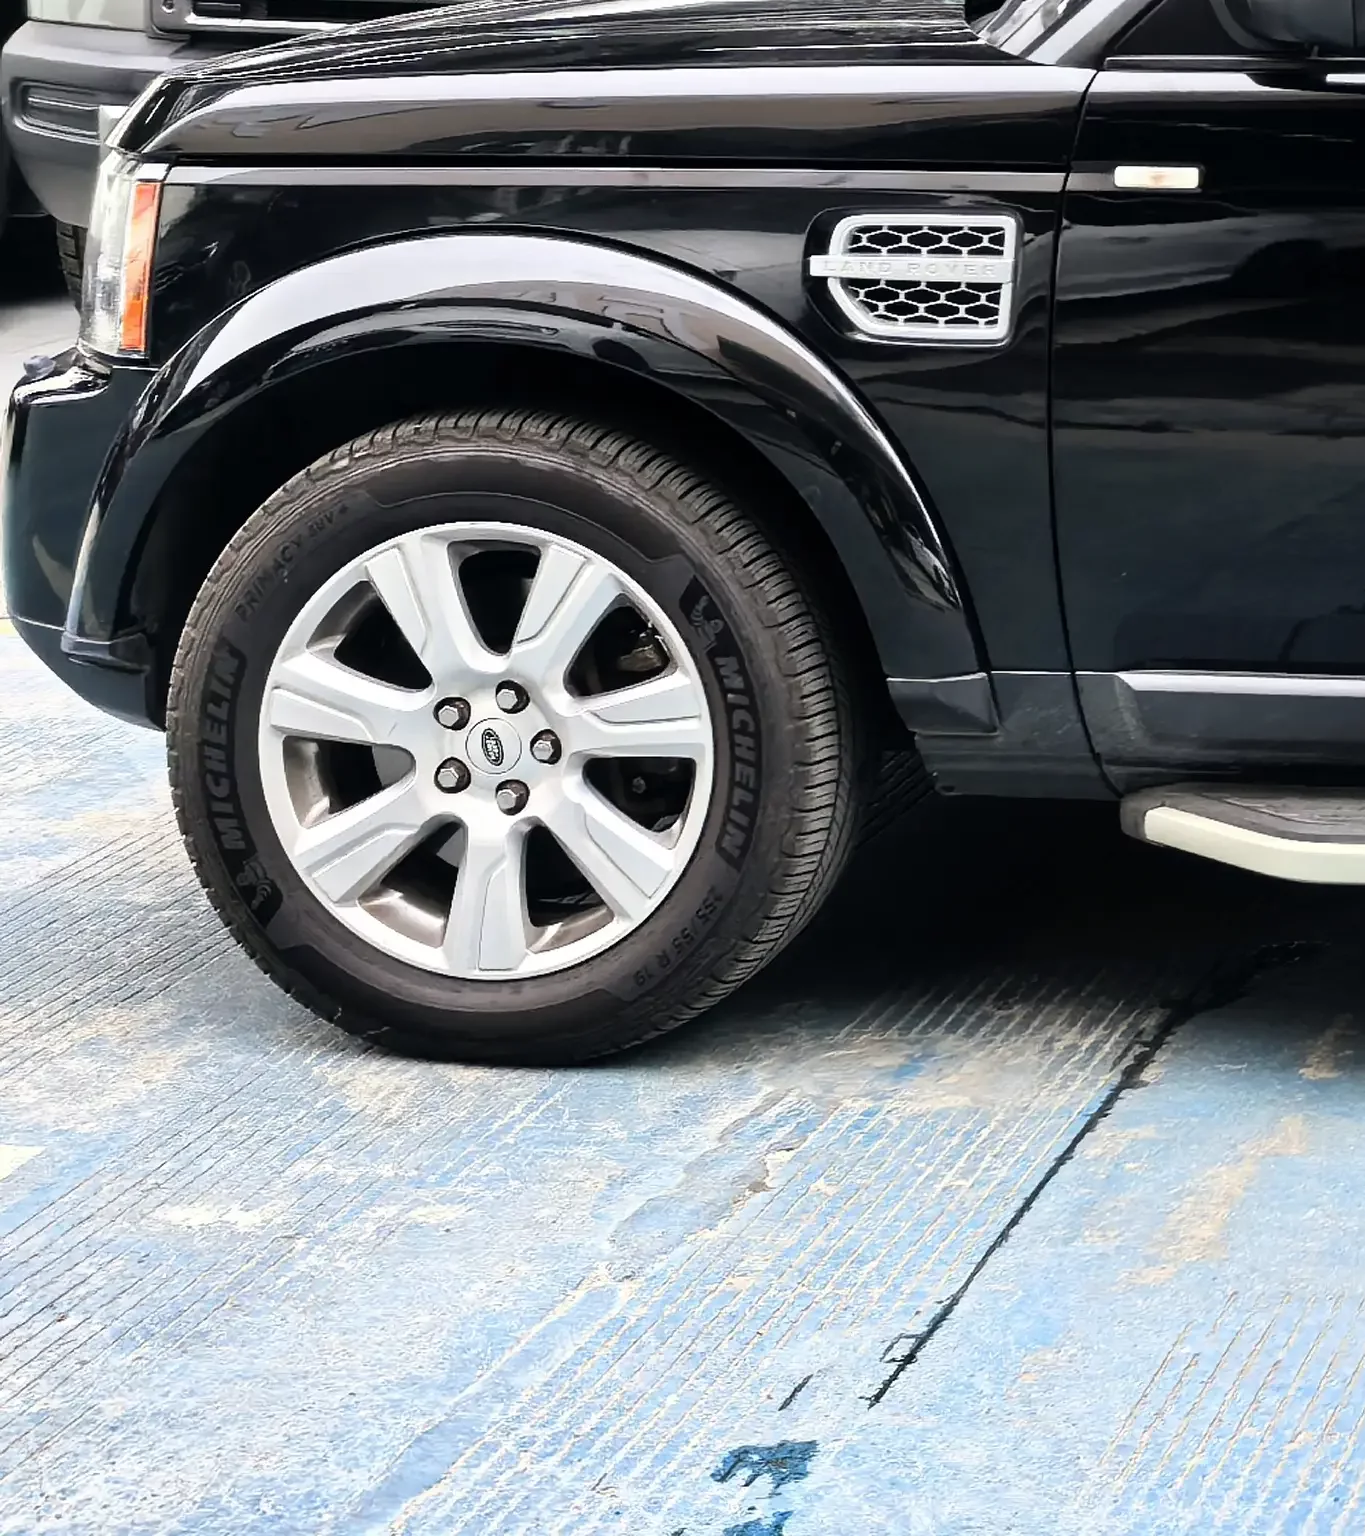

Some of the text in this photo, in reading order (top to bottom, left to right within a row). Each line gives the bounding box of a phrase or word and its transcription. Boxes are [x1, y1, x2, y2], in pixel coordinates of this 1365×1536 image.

[821, 260, 998, 278] LAND ROVER
[235, 536, 302, 621] PRIMACY
[203, 641, 248, 851] MICHELIN
[713, 656, 757, 859] MICHELIN
